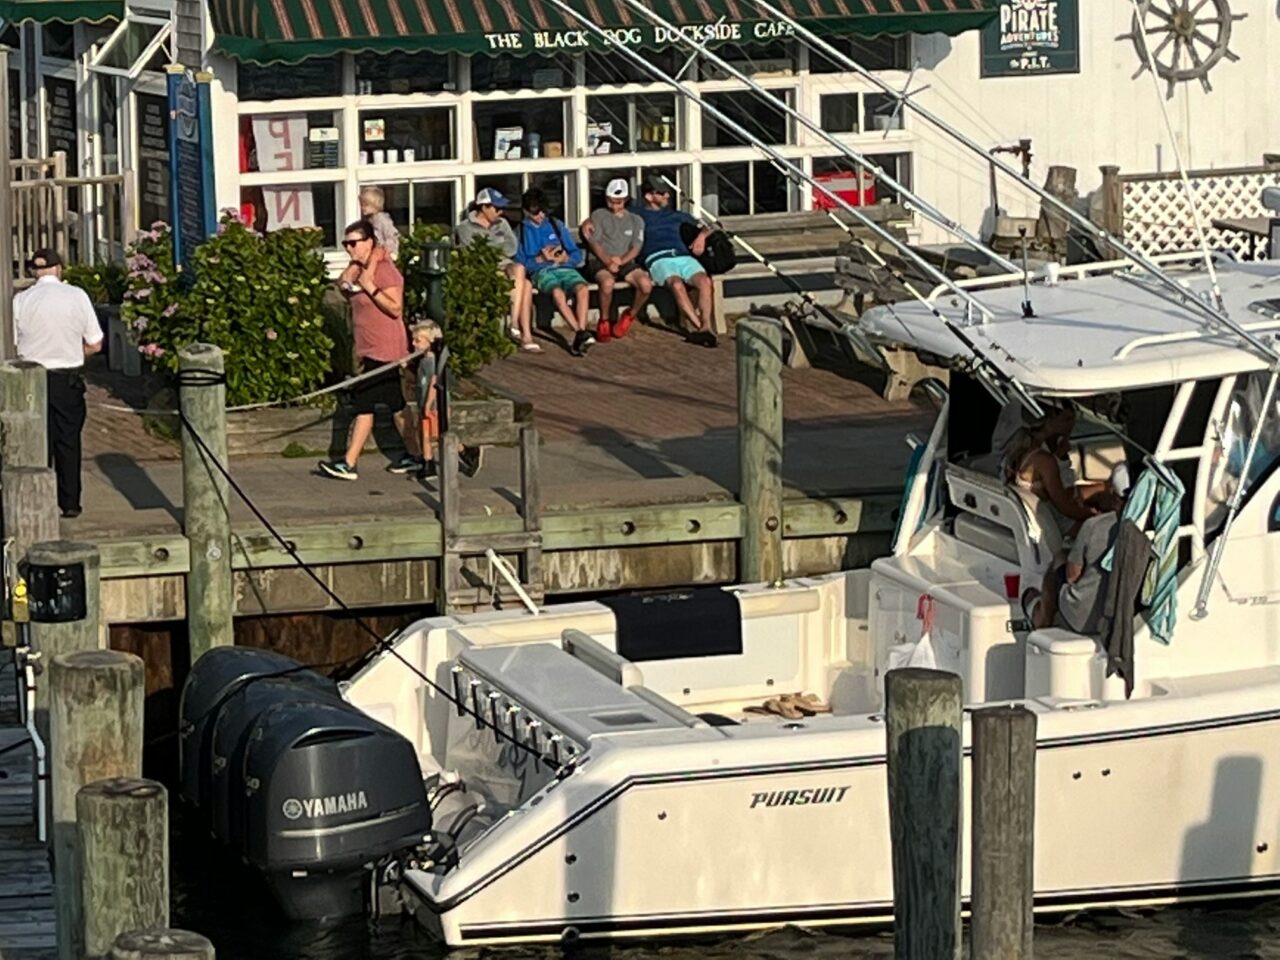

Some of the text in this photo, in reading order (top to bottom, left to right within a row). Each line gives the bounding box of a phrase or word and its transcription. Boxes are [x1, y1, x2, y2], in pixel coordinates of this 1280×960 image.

[485, 20, 796, 49] THE BLACK DOG DOCKSIDE CAFE
[302, 791, 368, 818] YAMAHA
[749, 785, 852, 809] PURSUIT
